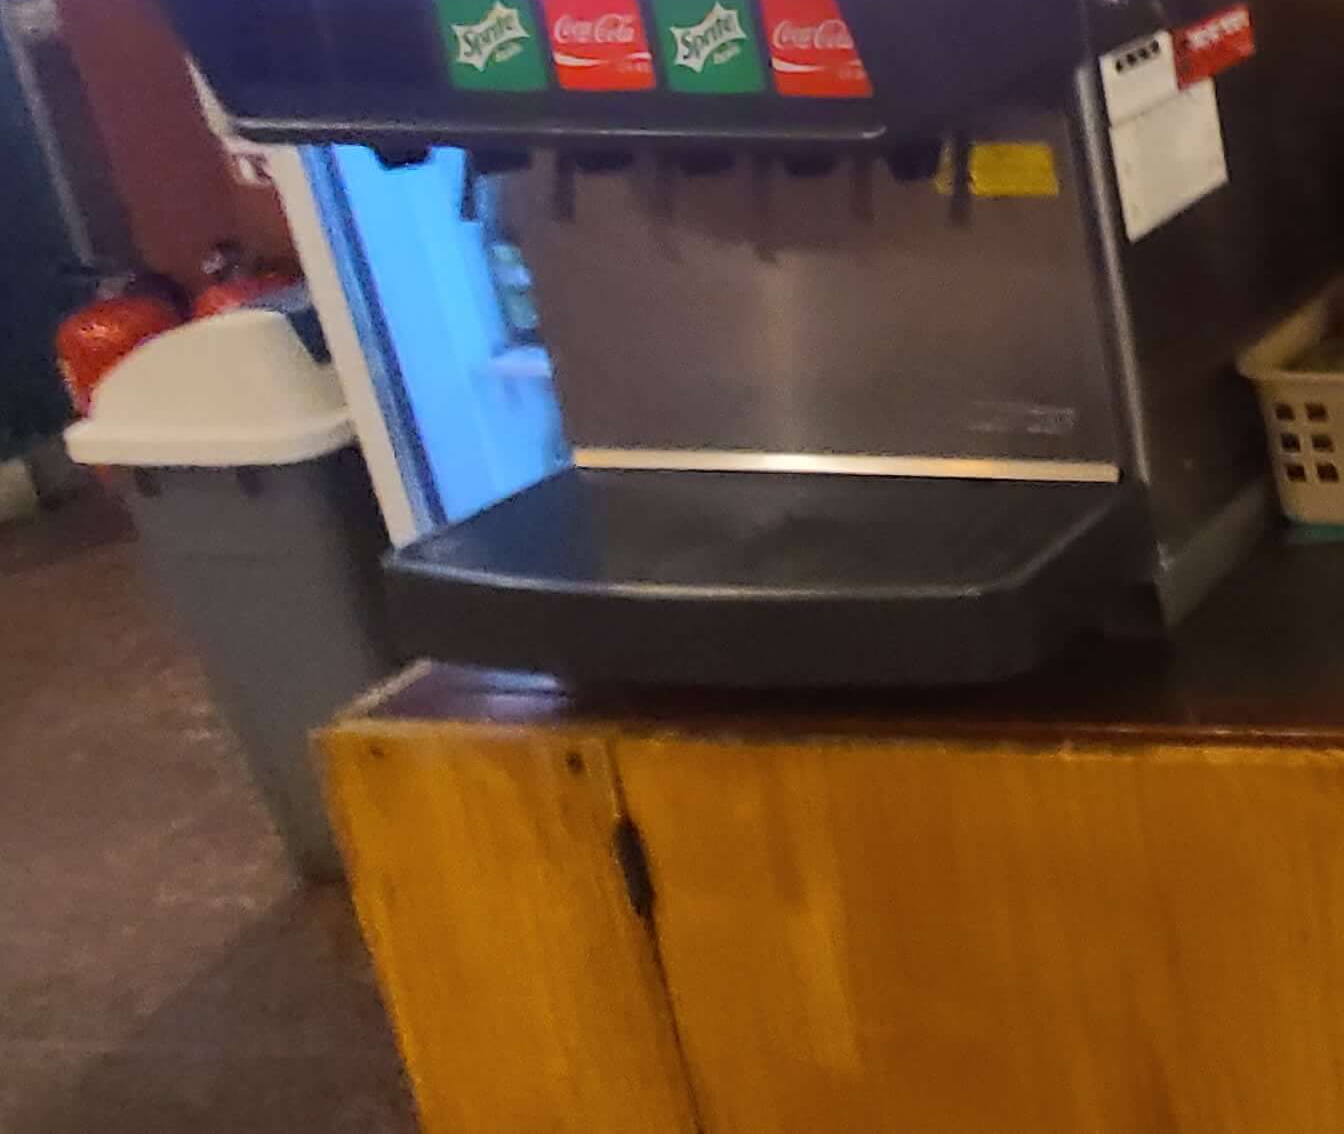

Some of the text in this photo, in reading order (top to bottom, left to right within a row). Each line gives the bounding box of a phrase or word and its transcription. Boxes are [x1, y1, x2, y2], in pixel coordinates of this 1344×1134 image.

[461, 15, 514, 58] Sprite
[554, 13, 635, 44] Coca-Cola
[680, 16, 737, 61] Sprite
[772, 18, 855, 50] Coca-Cola
